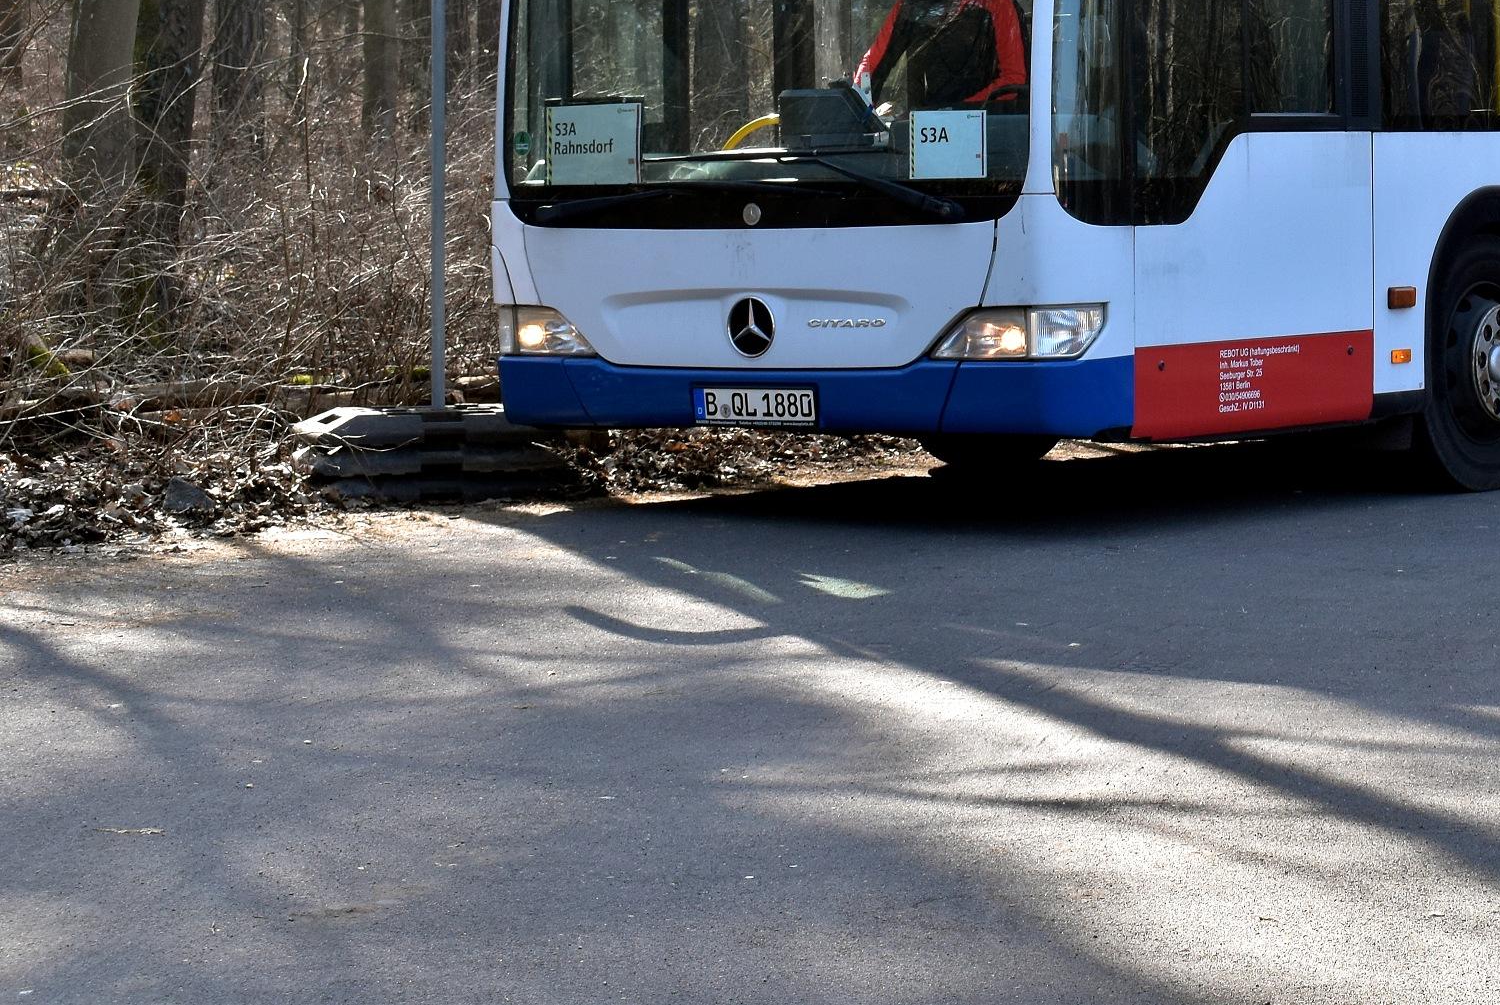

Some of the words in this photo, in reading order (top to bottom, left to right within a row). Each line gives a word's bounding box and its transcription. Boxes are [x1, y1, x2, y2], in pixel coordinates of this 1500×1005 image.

[554, 122, 577, 136] S3A
[919, 126, 949, 144] S3A
[554, 138, 614, 156] Rahnsdorf
[807, 317, 887, 329] CITARO
[1220, 349, 1238, 358] REBOT
[1240, 348, 1248, 356] UG
[1236, 381, 1250, 389] Berlin
[704, 392, 718, 416] B
[731, 393, 757, 417] QL
[762, 393, 813, 418] 1880
